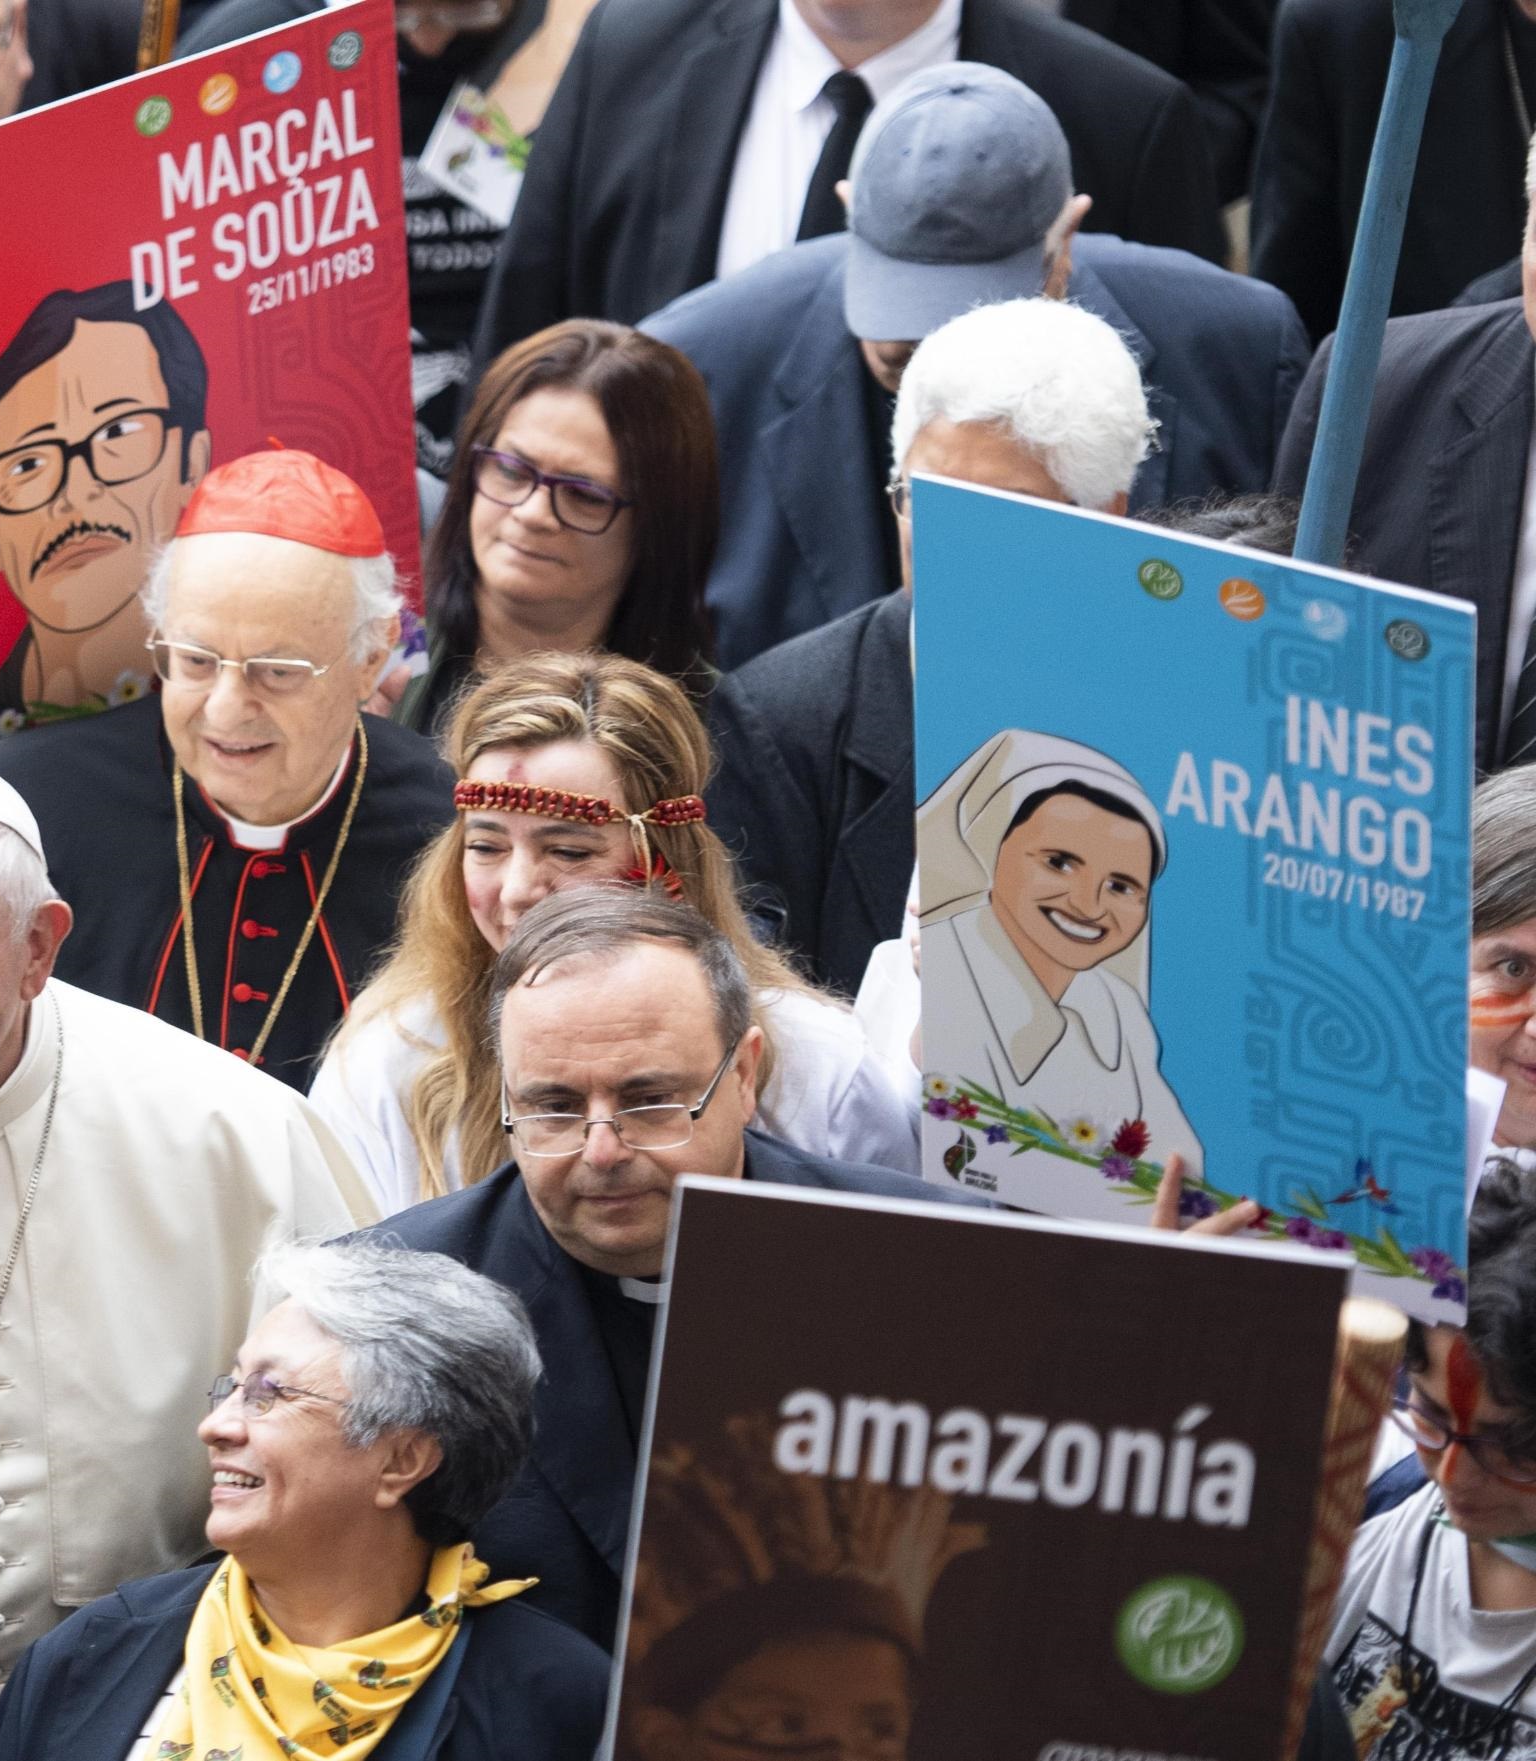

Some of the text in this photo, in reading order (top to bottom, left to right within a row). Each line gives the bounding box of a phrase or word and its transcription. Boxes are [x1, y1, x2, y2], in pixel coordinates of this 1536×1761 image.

[158, 88, 375, 221] MARÇAL
[130, 167, 380, 312] DE SOUZA
[247, 242, 376, 316] 25/11/1983
[1285, 692, 1435, 797] INES
[1165, 750, 1433, 879] ARANGO
[1263, 851, 1427, 922] 20/07/1987
[773, 1388, 1257, 1528] amazonía
